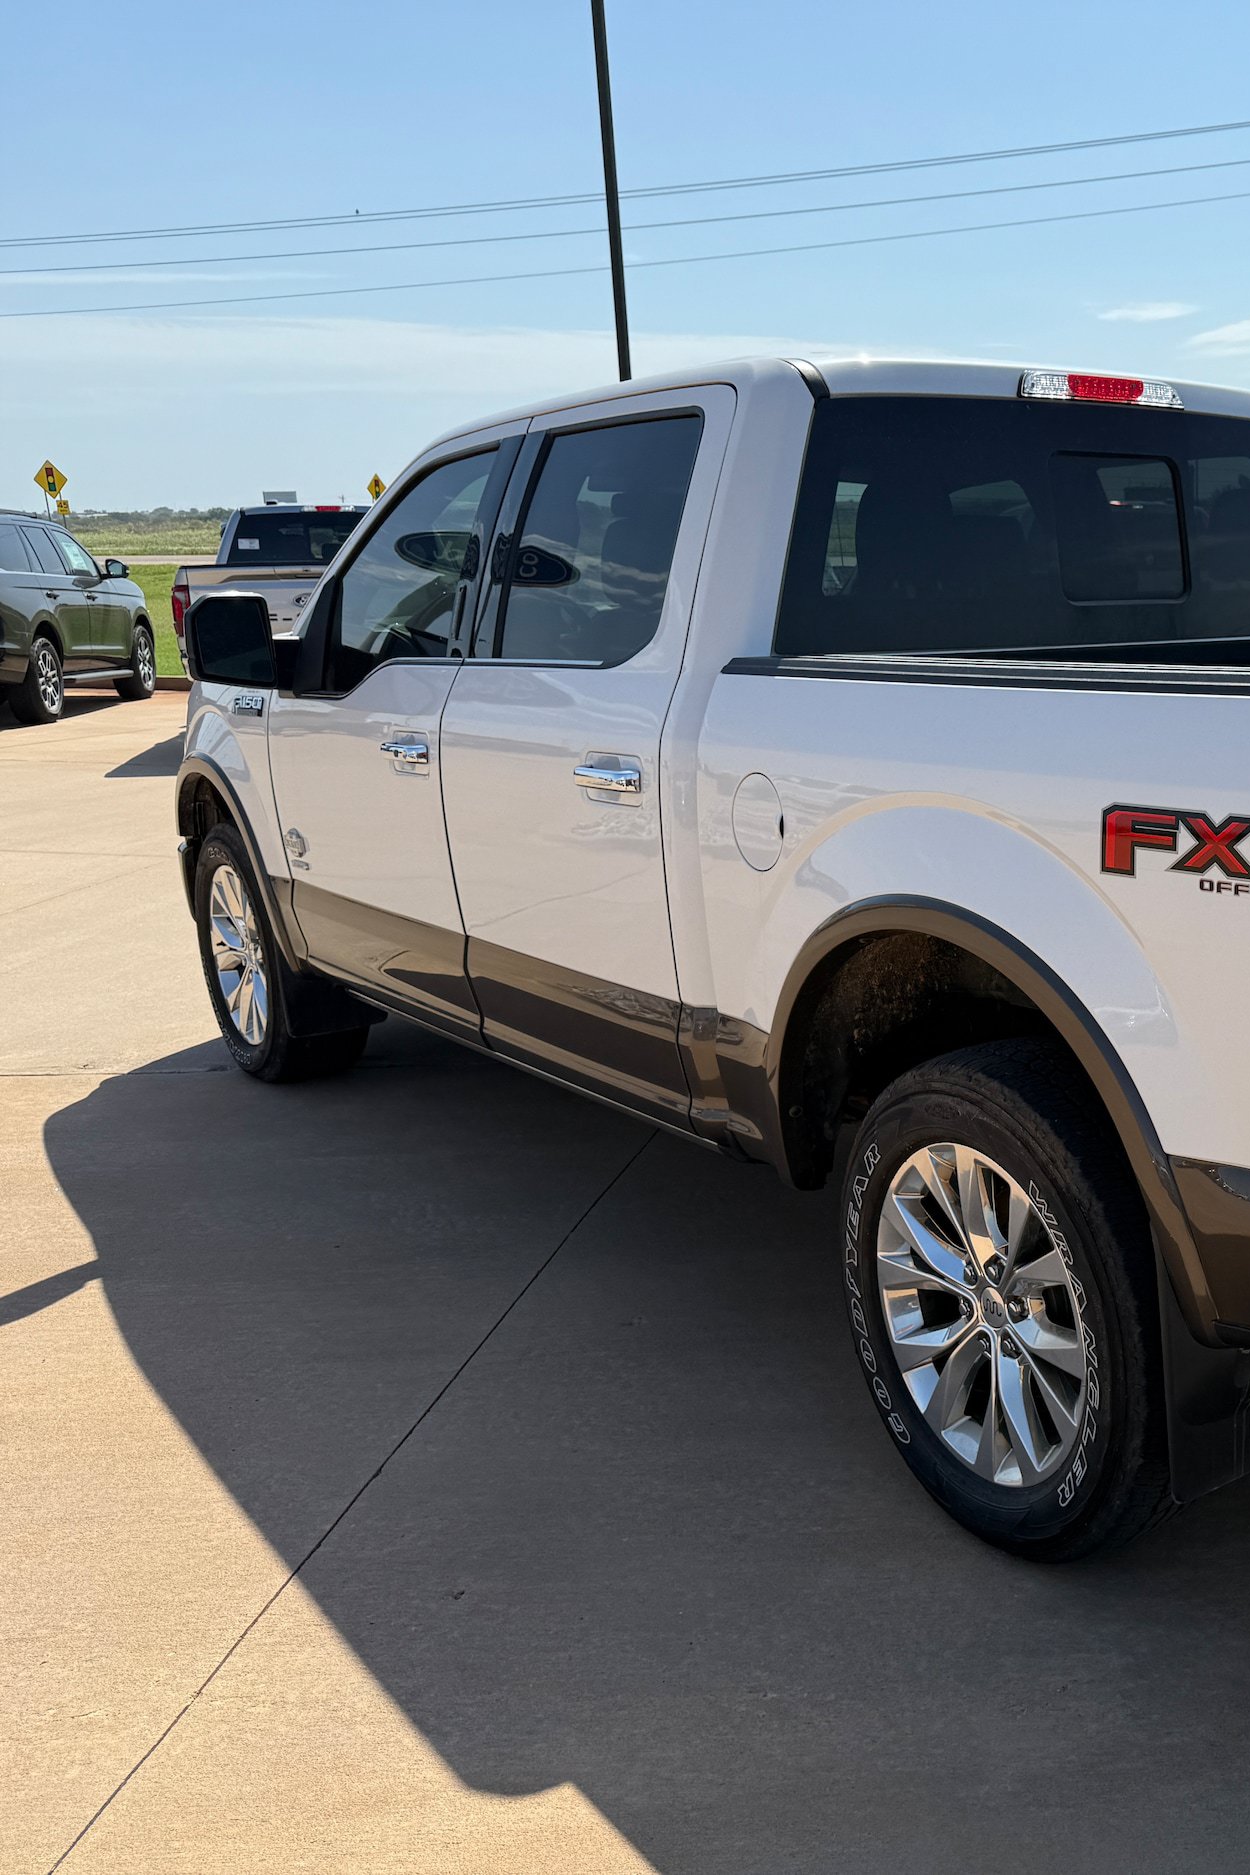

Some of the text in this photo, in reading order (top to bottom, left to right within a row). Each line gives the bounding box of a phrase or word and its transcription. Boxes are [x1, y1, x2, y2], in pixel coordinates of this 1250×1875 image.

[1199, 878, 1250, 896] OFF
[845, 1142, 911, 1445] GOODYEAR
[1029, 1179, 1100, 1508] WRANGLER
